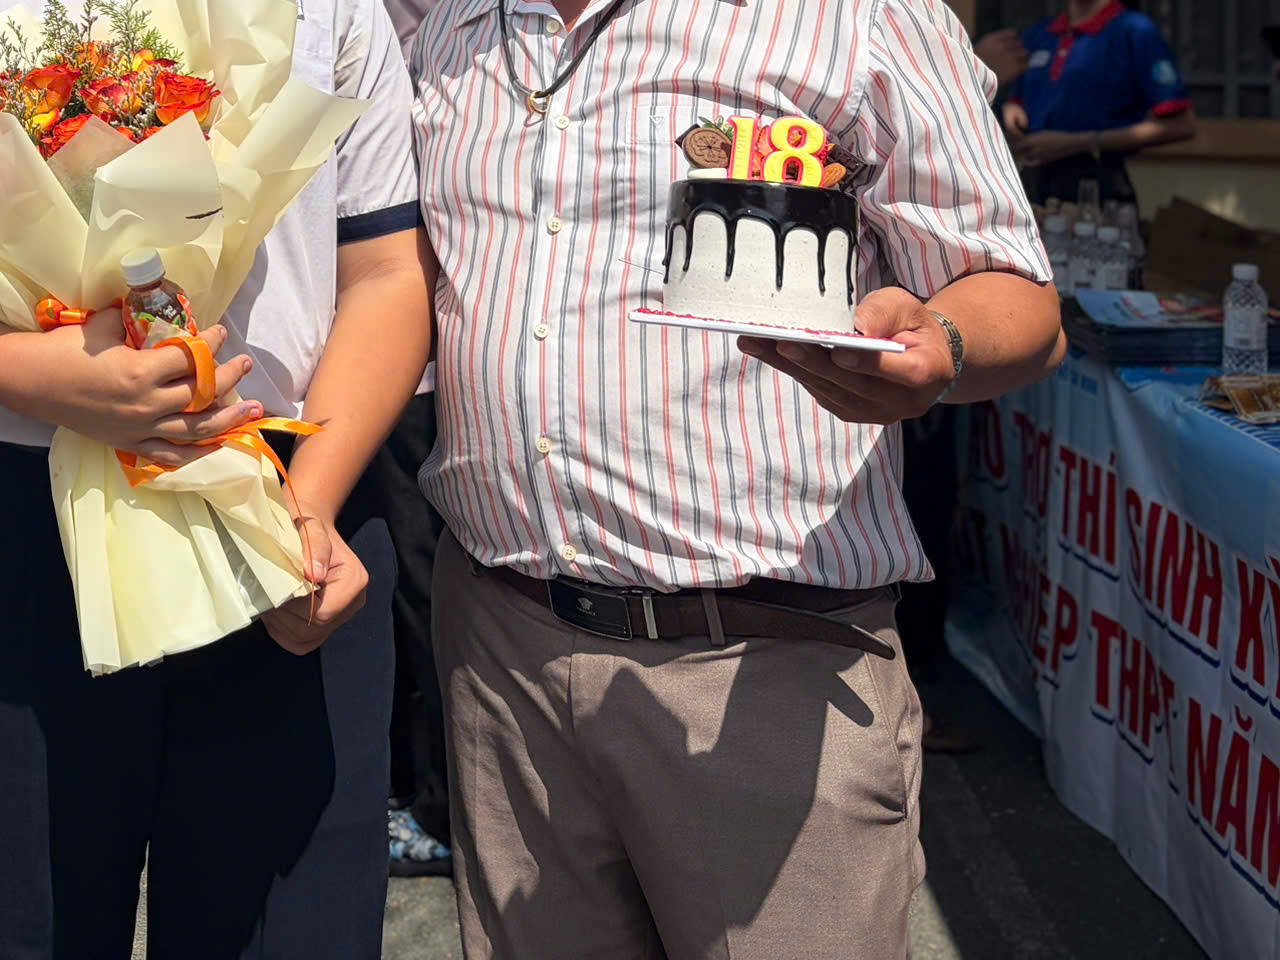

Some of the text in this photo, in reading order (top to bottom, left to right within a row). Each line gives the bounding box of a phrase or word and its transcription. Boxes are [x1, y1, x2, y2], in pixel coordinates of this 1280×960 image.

[727, 115, 828, 188] 18
[1059, 449, 1118, 567] THÍ
[1125, 487, 1223, 651] SINH
